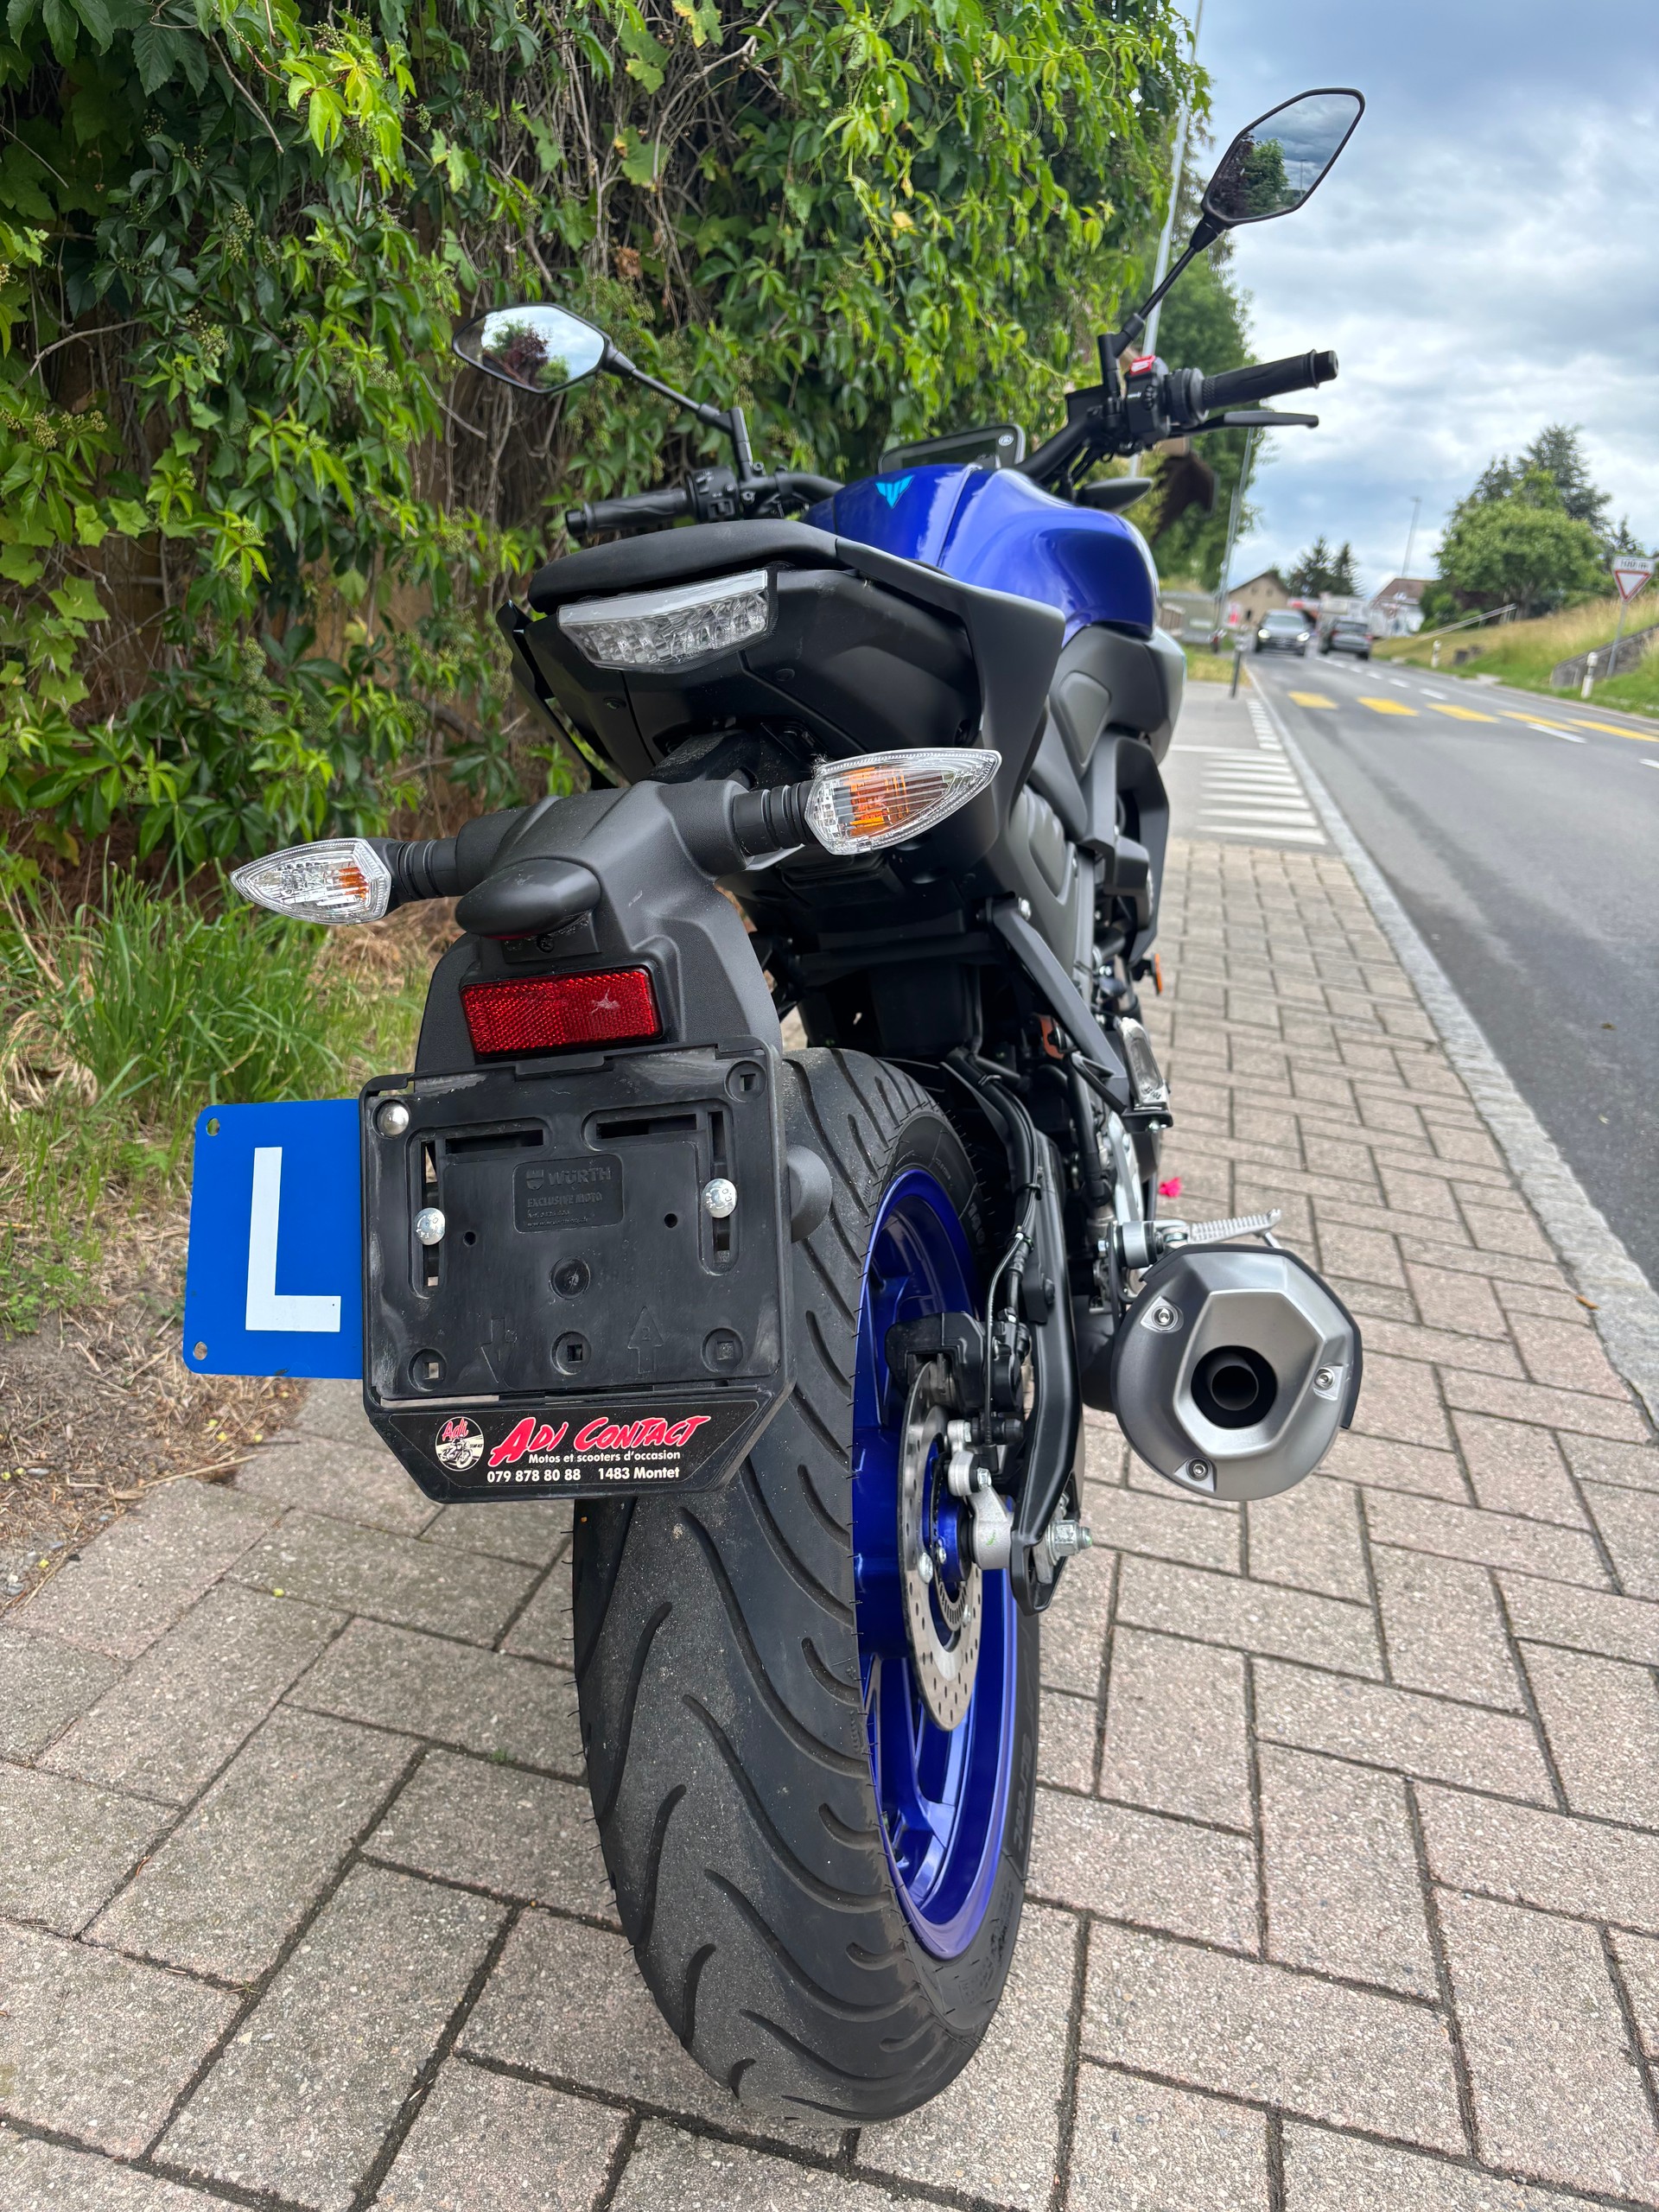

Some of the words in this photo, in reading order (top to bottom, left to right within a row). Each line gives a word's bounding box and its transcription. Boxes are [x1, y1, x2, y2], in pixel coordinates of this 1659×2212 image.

[548, 1166, 613, 1186] WÜRTH
[527, 1194, 574, 1207] EXCLUSIVE
[245, 1147, 341, 1332] L
[442, 1417, 469, 1442] Adi
[573, 1415, 711, 1452] CONTACT
[528, 1453, 561, 1464] Motos
[563, 1453, 574, 1463] et
[576, 1452, 621, 1463] scooters
[623, 1450, 681, 1461] d'occasion
[486, 1471, 512, 1484] 079
[515, 1470, 540, 1483] 878
[543, 1469, 561, 1482] 80
[564, 1468, 582, 1481] 88
[598, 1466, 631, 1480] 1483
[633, 1466, 680, 1479] Montet
